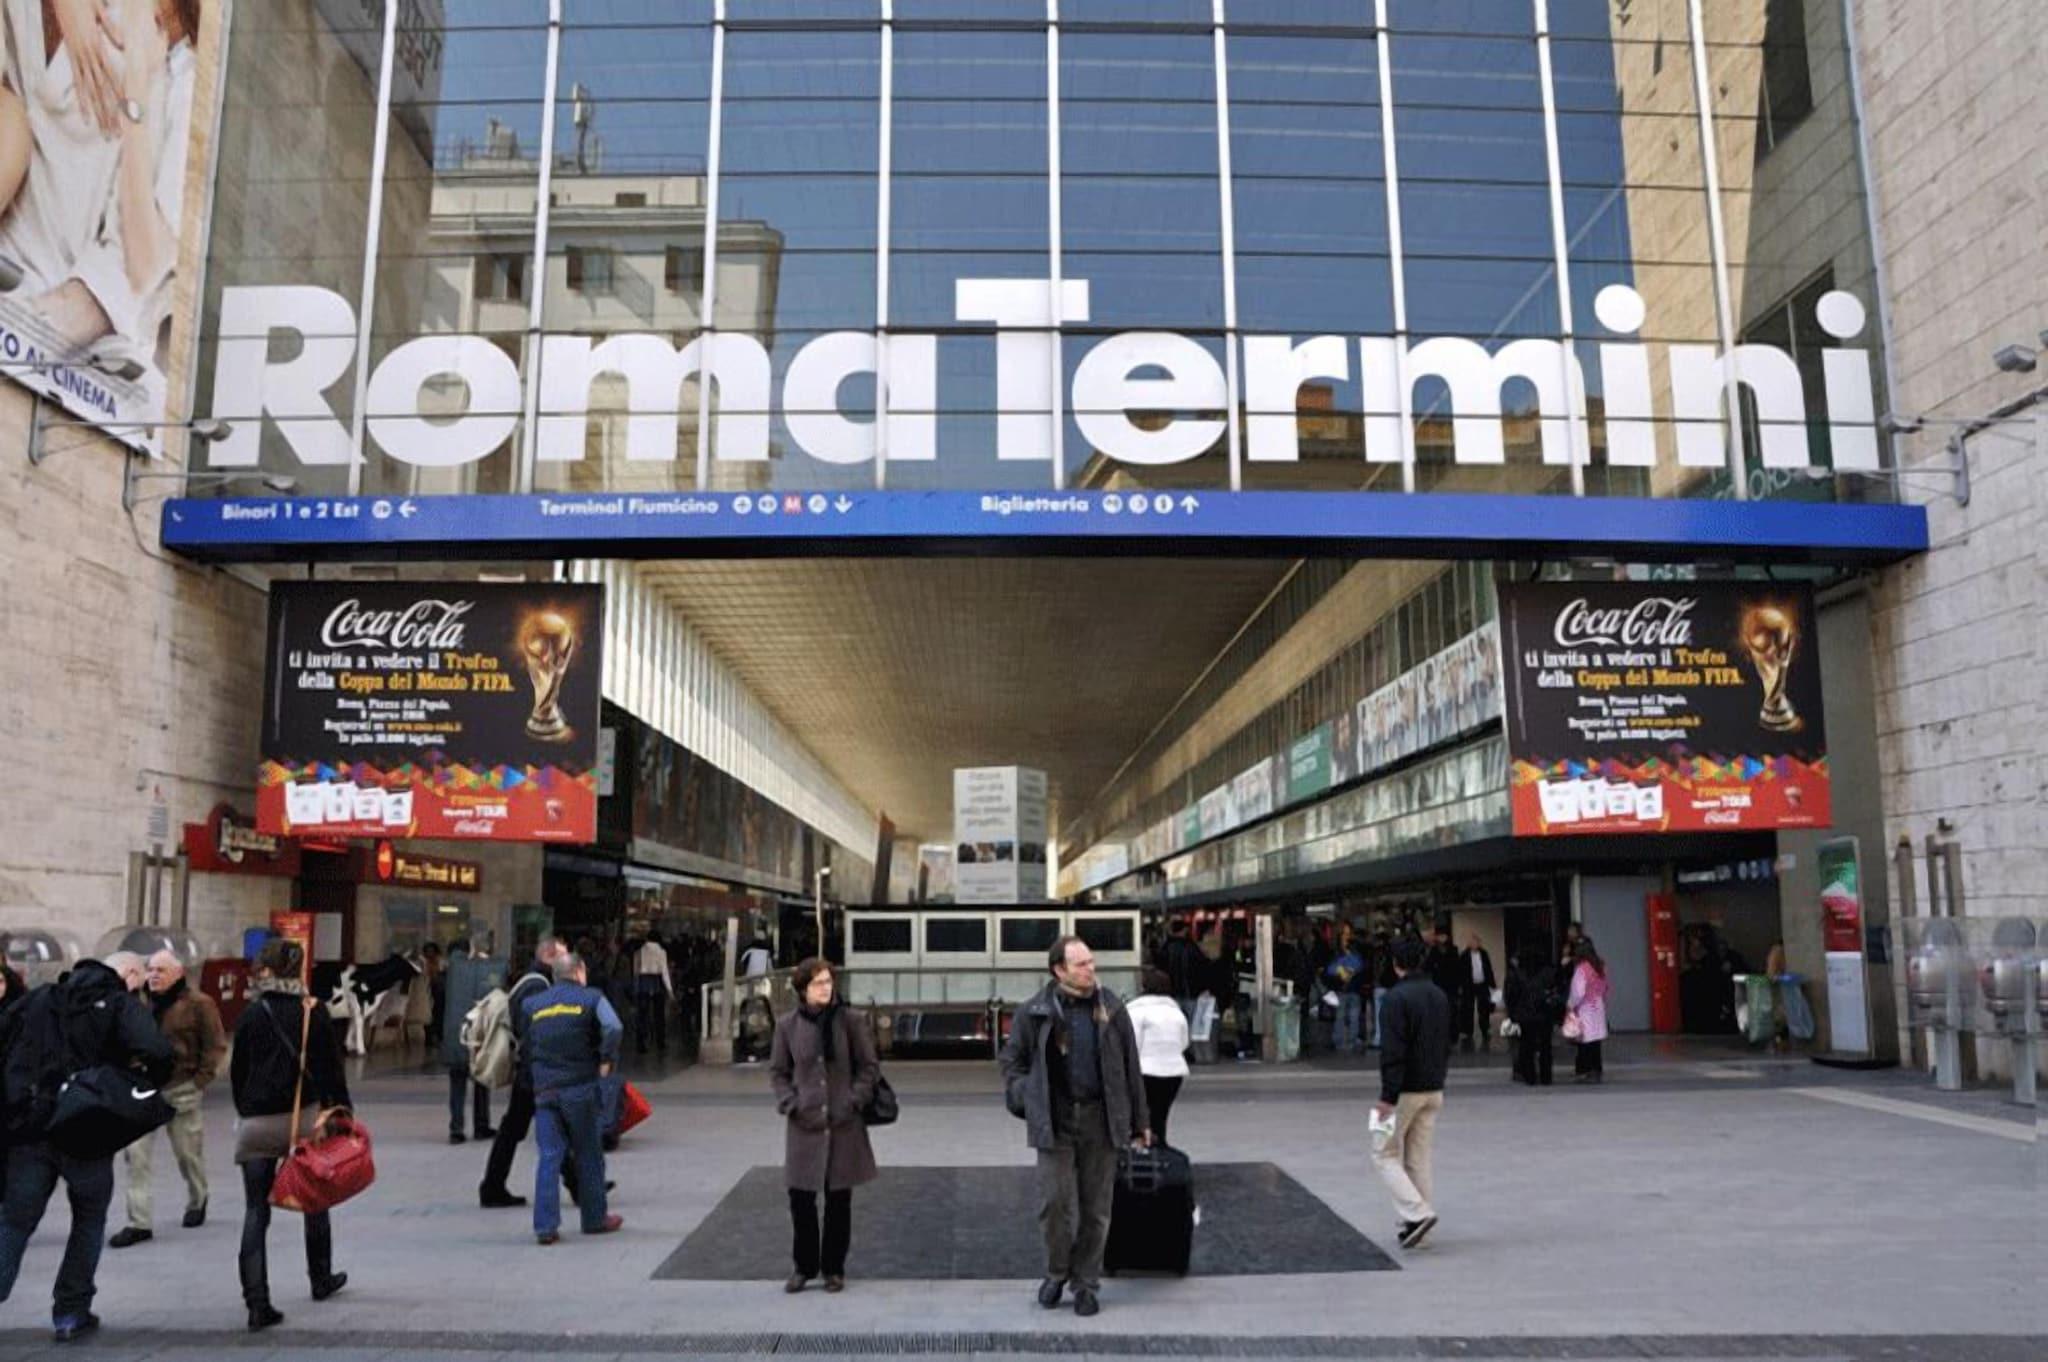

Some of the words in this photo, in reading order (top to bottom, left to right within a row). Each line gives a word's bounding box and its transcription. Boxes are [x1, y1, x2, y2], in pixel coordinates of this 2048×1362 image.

[52, 364, 117, 419] CINEMA
[221, 503, 277, 520] Binari
[285, 503, 292, 519] 1
[300, 506, 311, 519] e
[317, 502, 328, 518] 2
[334, 502, 359, 518] Est
[540, 497, 624, 516] Terminal
[628, 496, 719, 515] Fiumicino
[981, 495, 1090, 515] Biglietteria
[306, 650, 353, 669] invita
[357, 655, 367, 669] a
[372, 652, 424, 669] vedere
[428, 652, 440, 669] il
[443, 653, 498, 670] Trofeo
[1543, 649, 1588, 667] invita
[1592, 653, 1603, 667] a
[1606, 650, 1657, 667] vedere
[1661, 648, 1673, 666] il
[1674, 648, 1727, 666] Trofeo
[298, 671, 336, 689] della
[339, 672, 384, 693] Coppa
[388, 672, 413, 690] del
[416, 672, 468, 690] Mondo
[1537, 670, 1575, 688] della
[1577, 669, 1621, 690] Coppa
[1625, 669, 1648, 687] del
[1652, 668, 1700, 686] Mondo
